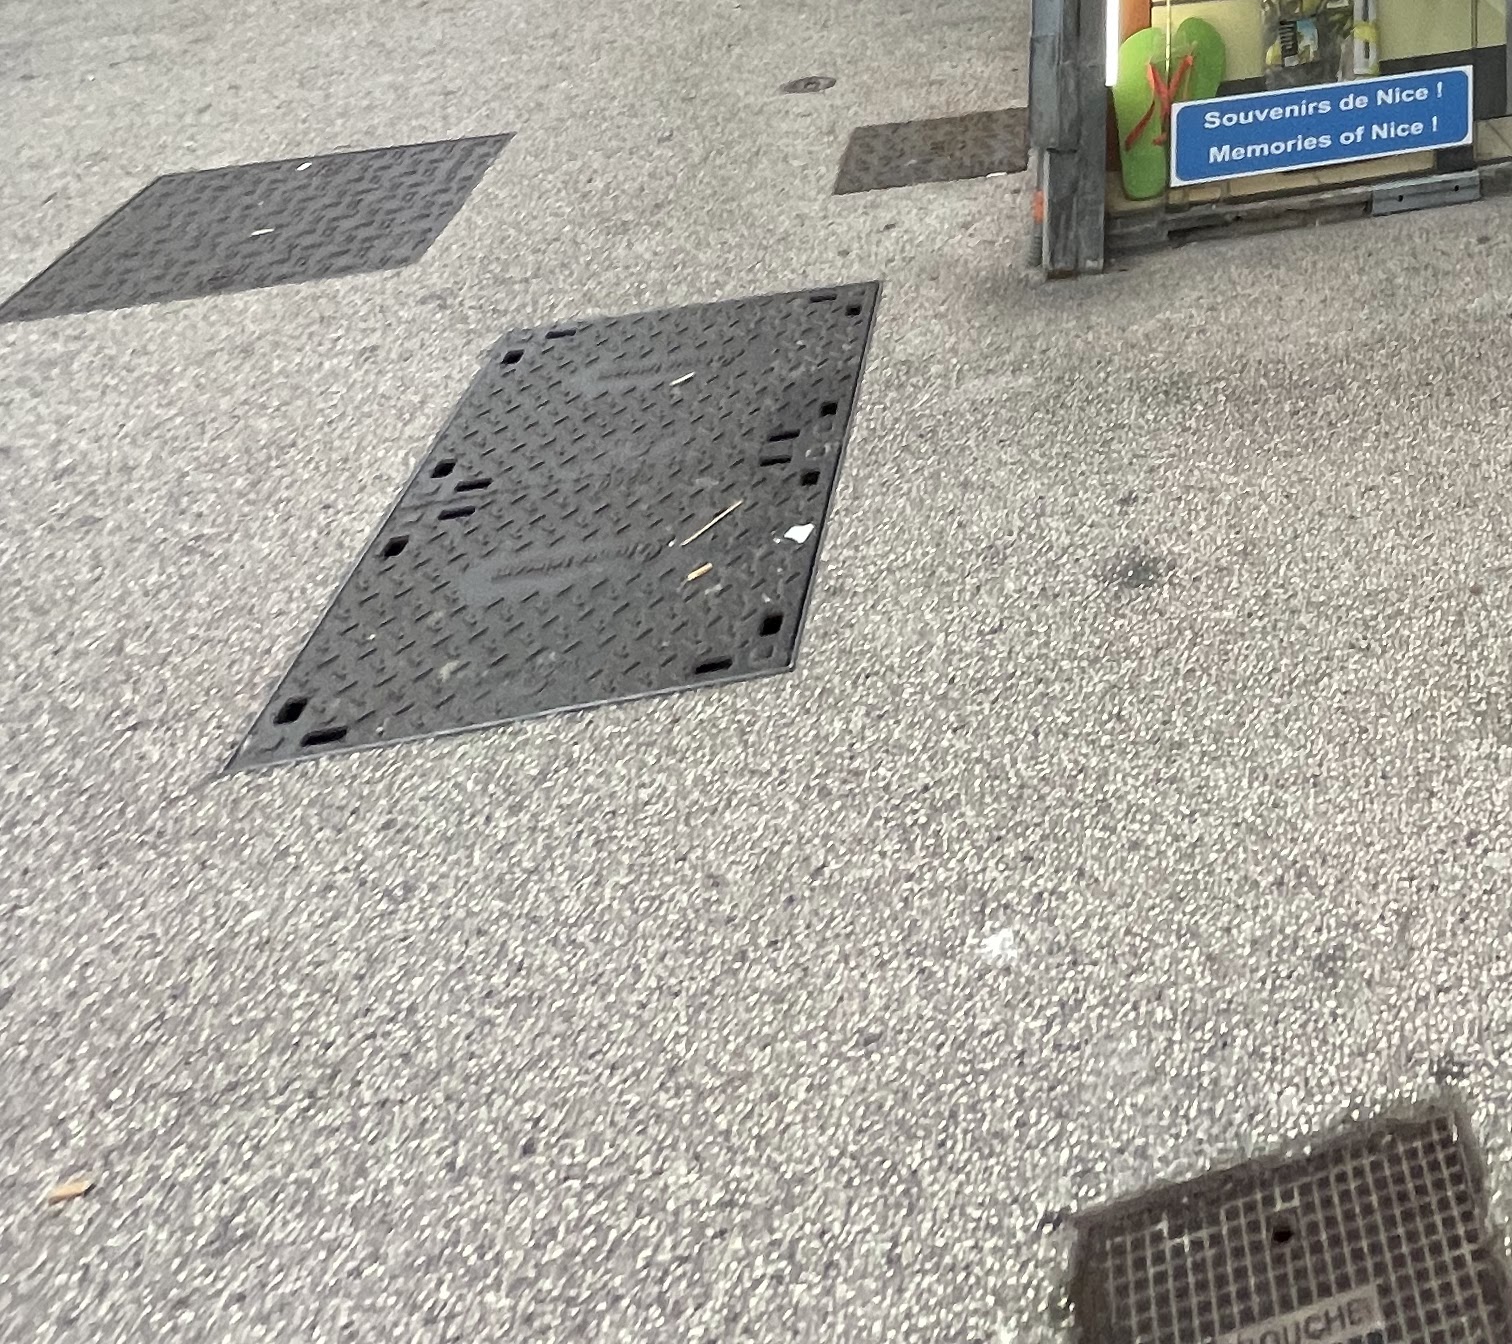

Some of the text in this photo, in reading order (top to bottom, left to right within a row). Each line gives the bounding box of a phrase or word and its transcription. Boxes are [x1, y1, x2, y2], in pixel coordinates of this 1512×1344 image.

[1204, 100, 1331, 129] Souvenirs
[1339, 92, 1368, 112] de
[1377, 81, 1428, 105] Nice
[1209, 135, 1331, 164] Memories
[1339, 124, 1365, 146] of
[1371, 116, 1424, 140] Nice
